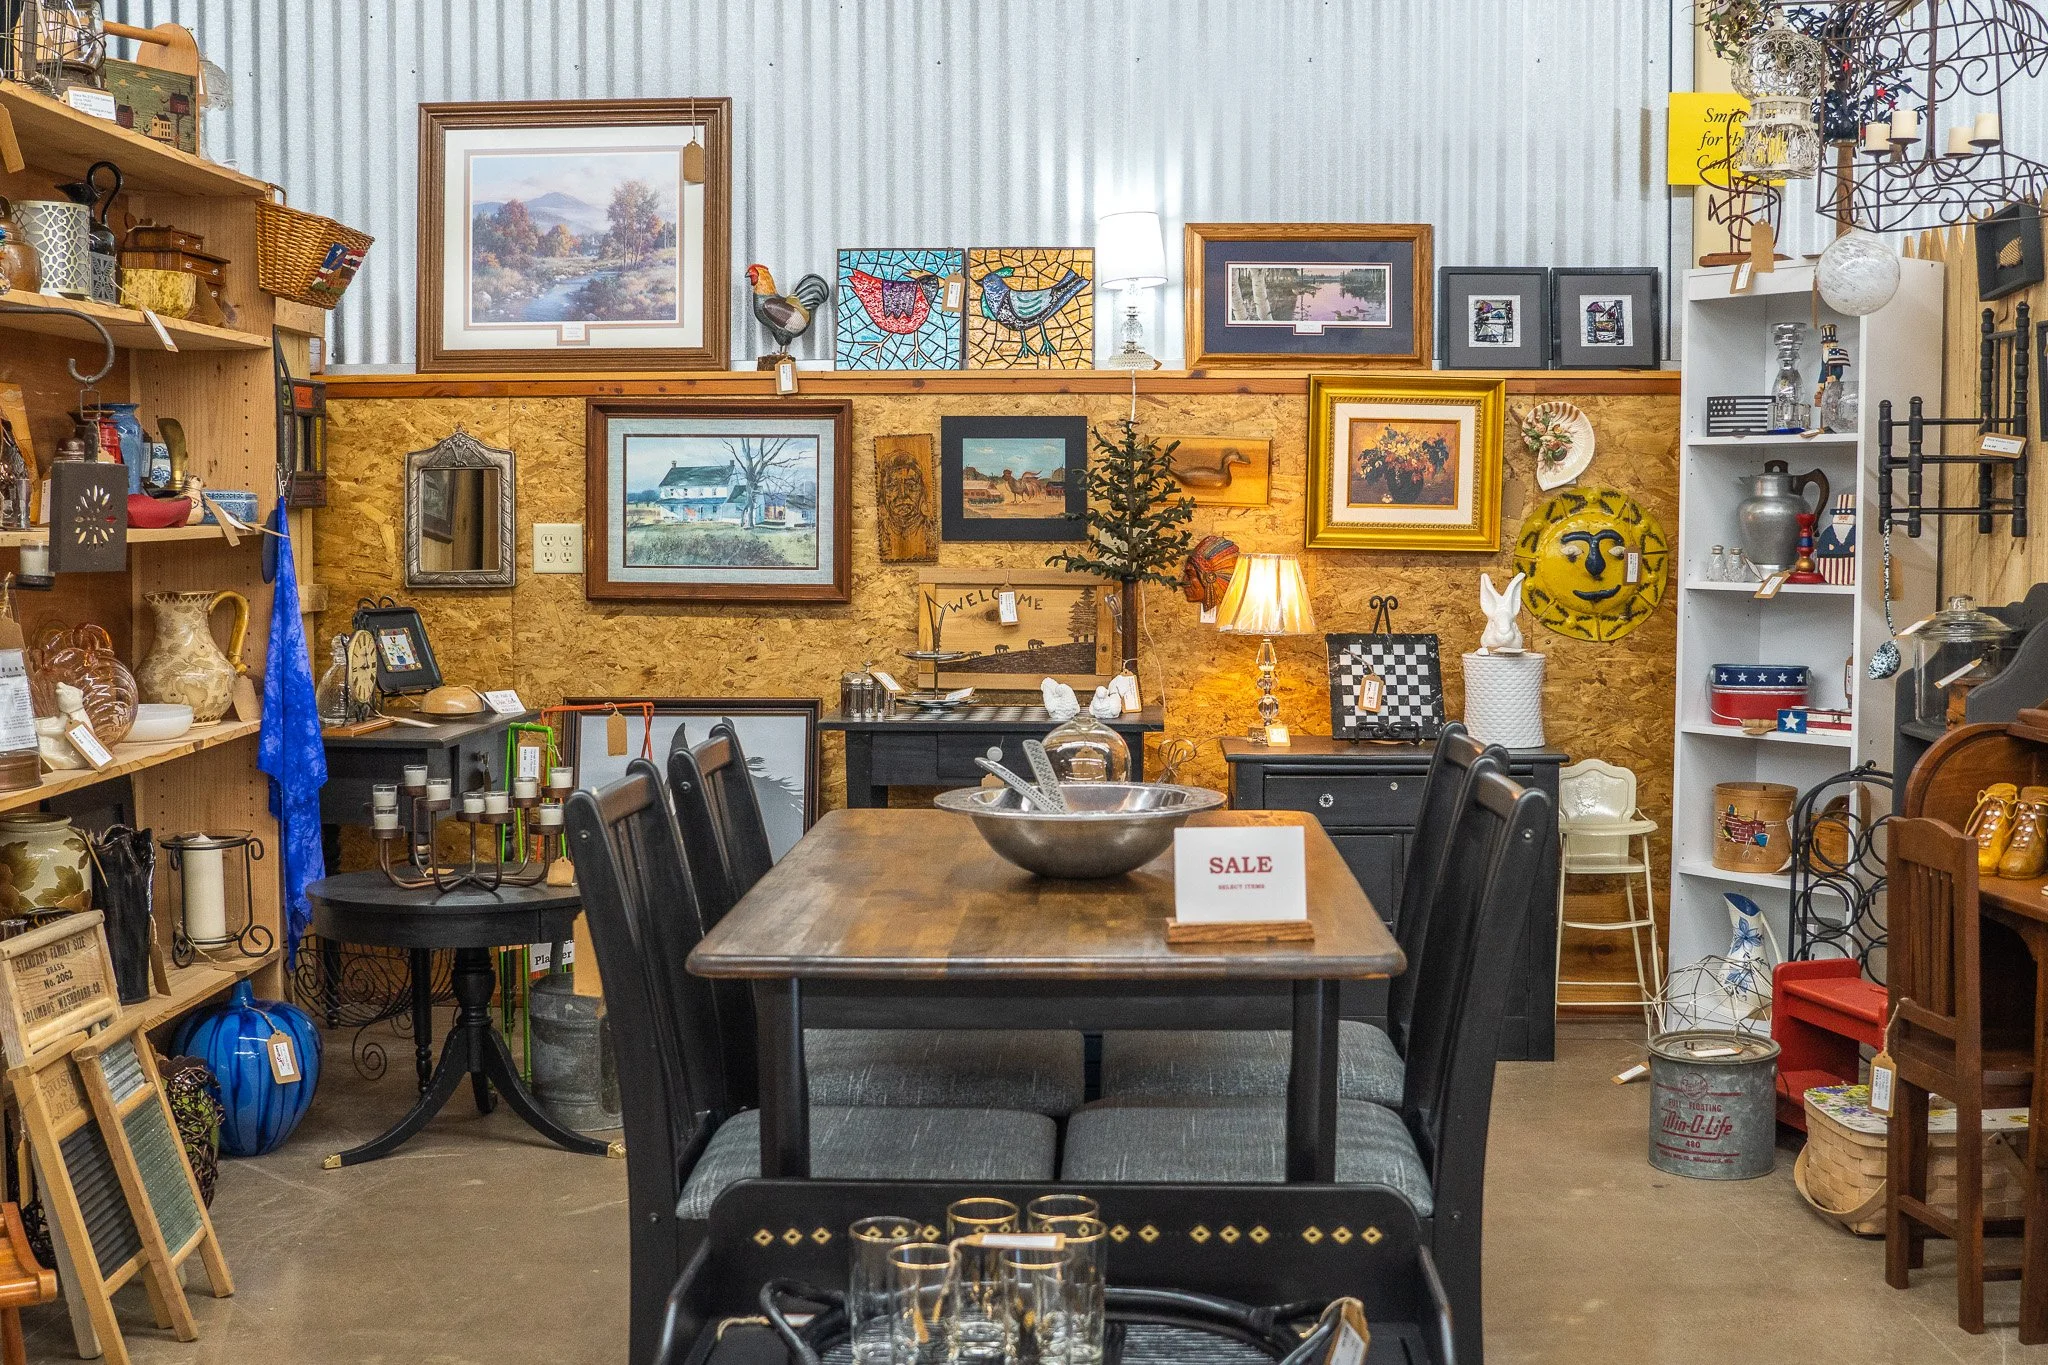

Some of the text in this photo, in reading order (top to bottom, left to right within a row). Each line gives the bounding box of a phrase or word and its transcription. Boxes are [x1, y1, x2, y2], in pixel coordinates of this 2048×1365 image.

[1704, 107, 1745, 123] Smle
[1697, 130, 1723, 151] for
[1696, 154, 1742, 169] Came
[949, 587, 1044, 613] WELCME
[1209, 855, 1273, 874] SALE
[15, 951, 48, 974] STANDARD
[73, 935, 86, 953] SIZE
[535, 951, 572, 965] Plaer
[45, 962, 65, 975] BRASS
[43, 969, 74, 989] No. 2062
[1688, 1102, 1722, 1112] FLOATING
